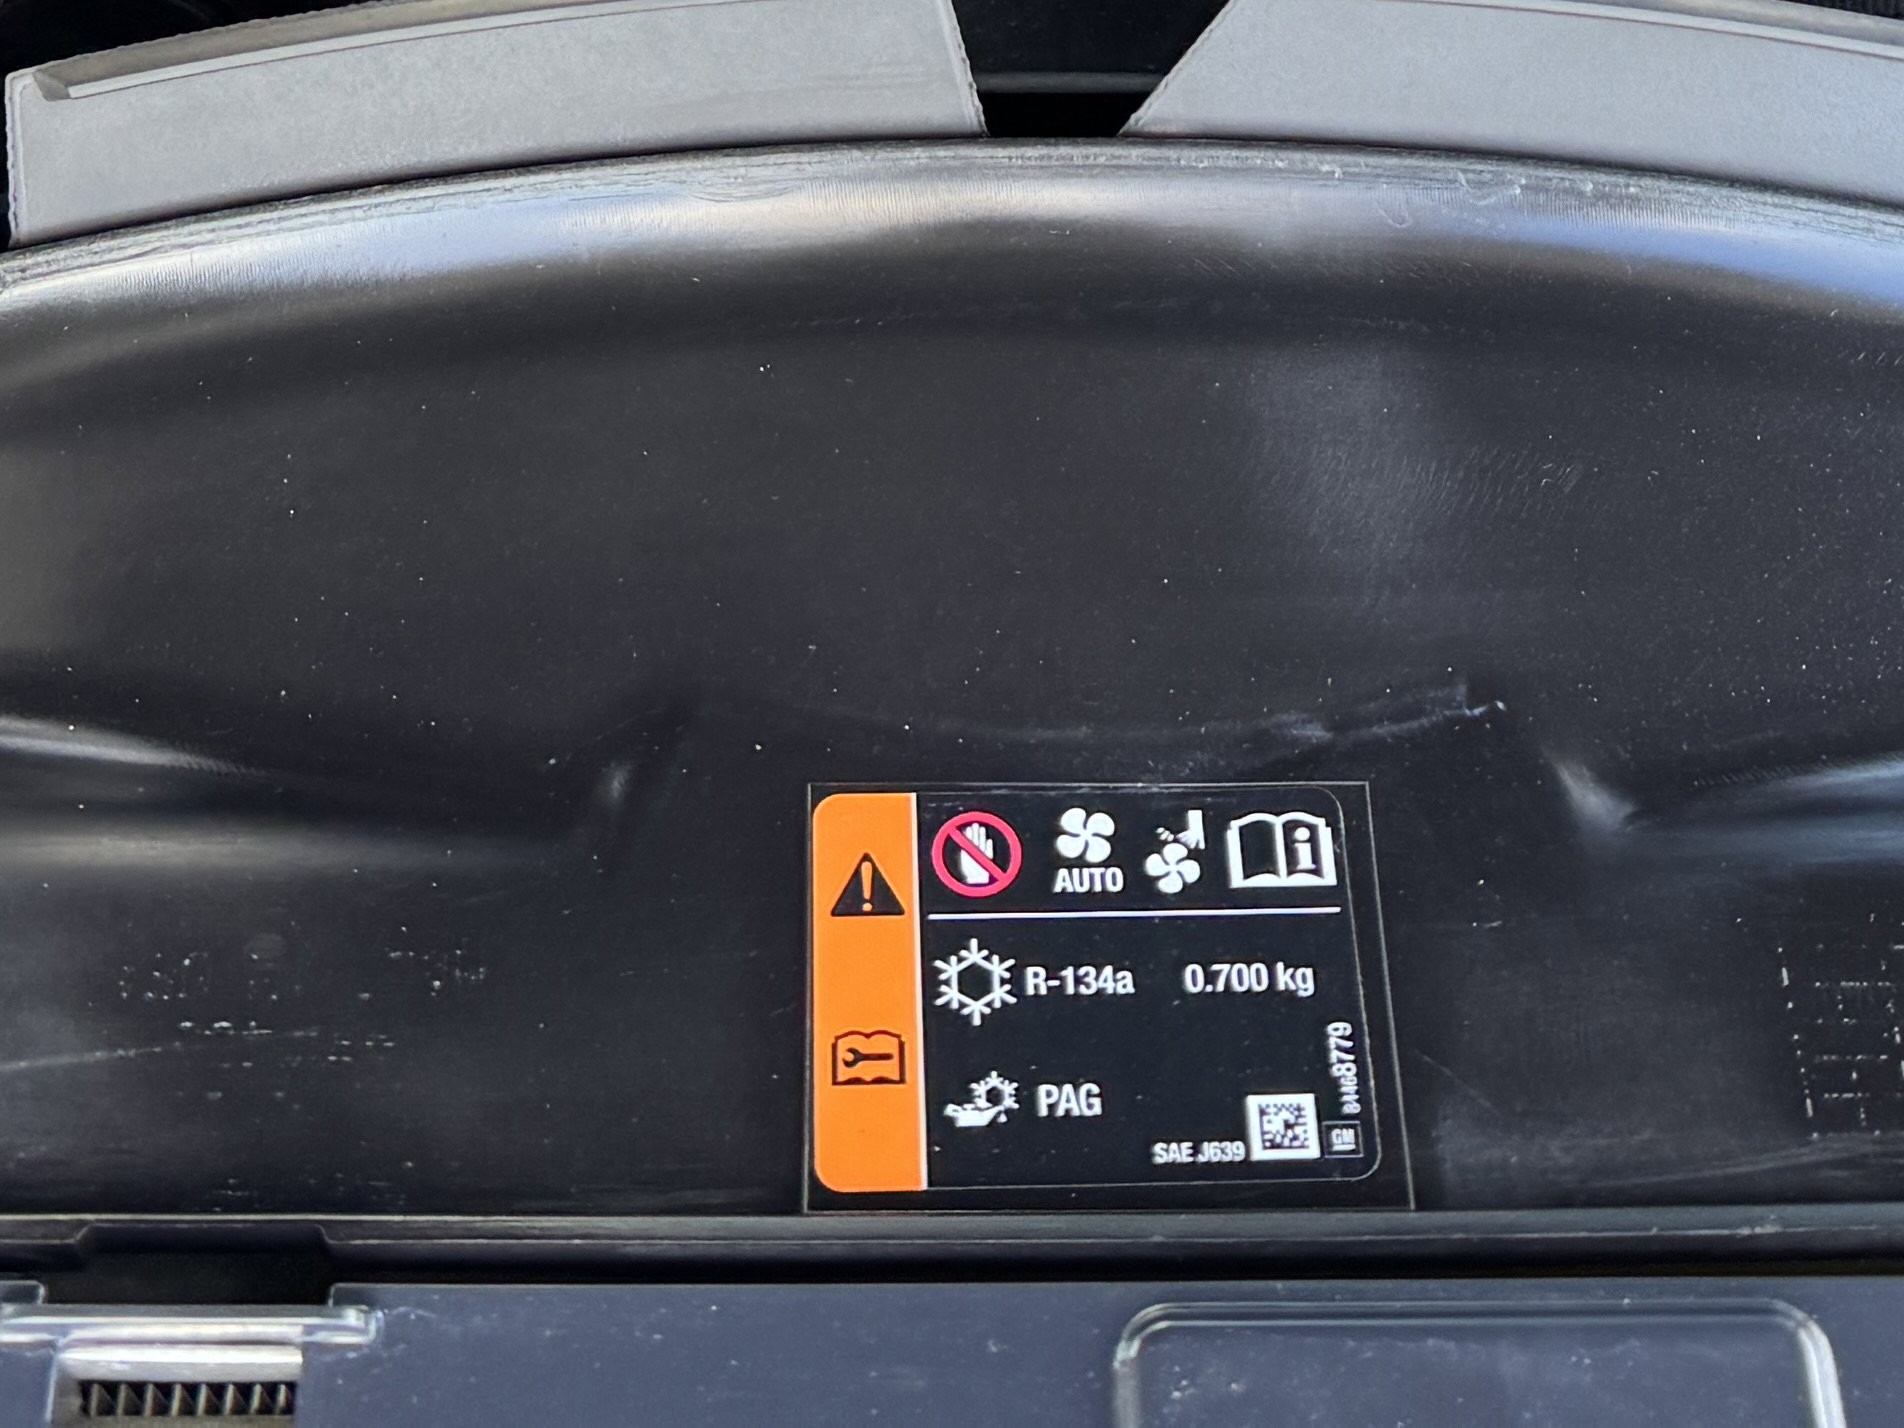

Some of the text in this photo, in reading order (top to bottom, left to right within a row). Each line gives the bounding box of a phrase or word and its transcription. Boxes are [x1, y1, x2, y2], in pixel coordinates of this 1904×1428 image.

[1053, 867, 1124, 894] AUTO
[1025, 962, 1316, 997] R-134a 0.700 kg
[1036, 1084, 1103, 1118] PAG
[1331, 1127, 1356, 1147] GM
[1153, 1141, 1246, 1164] SAE J639
